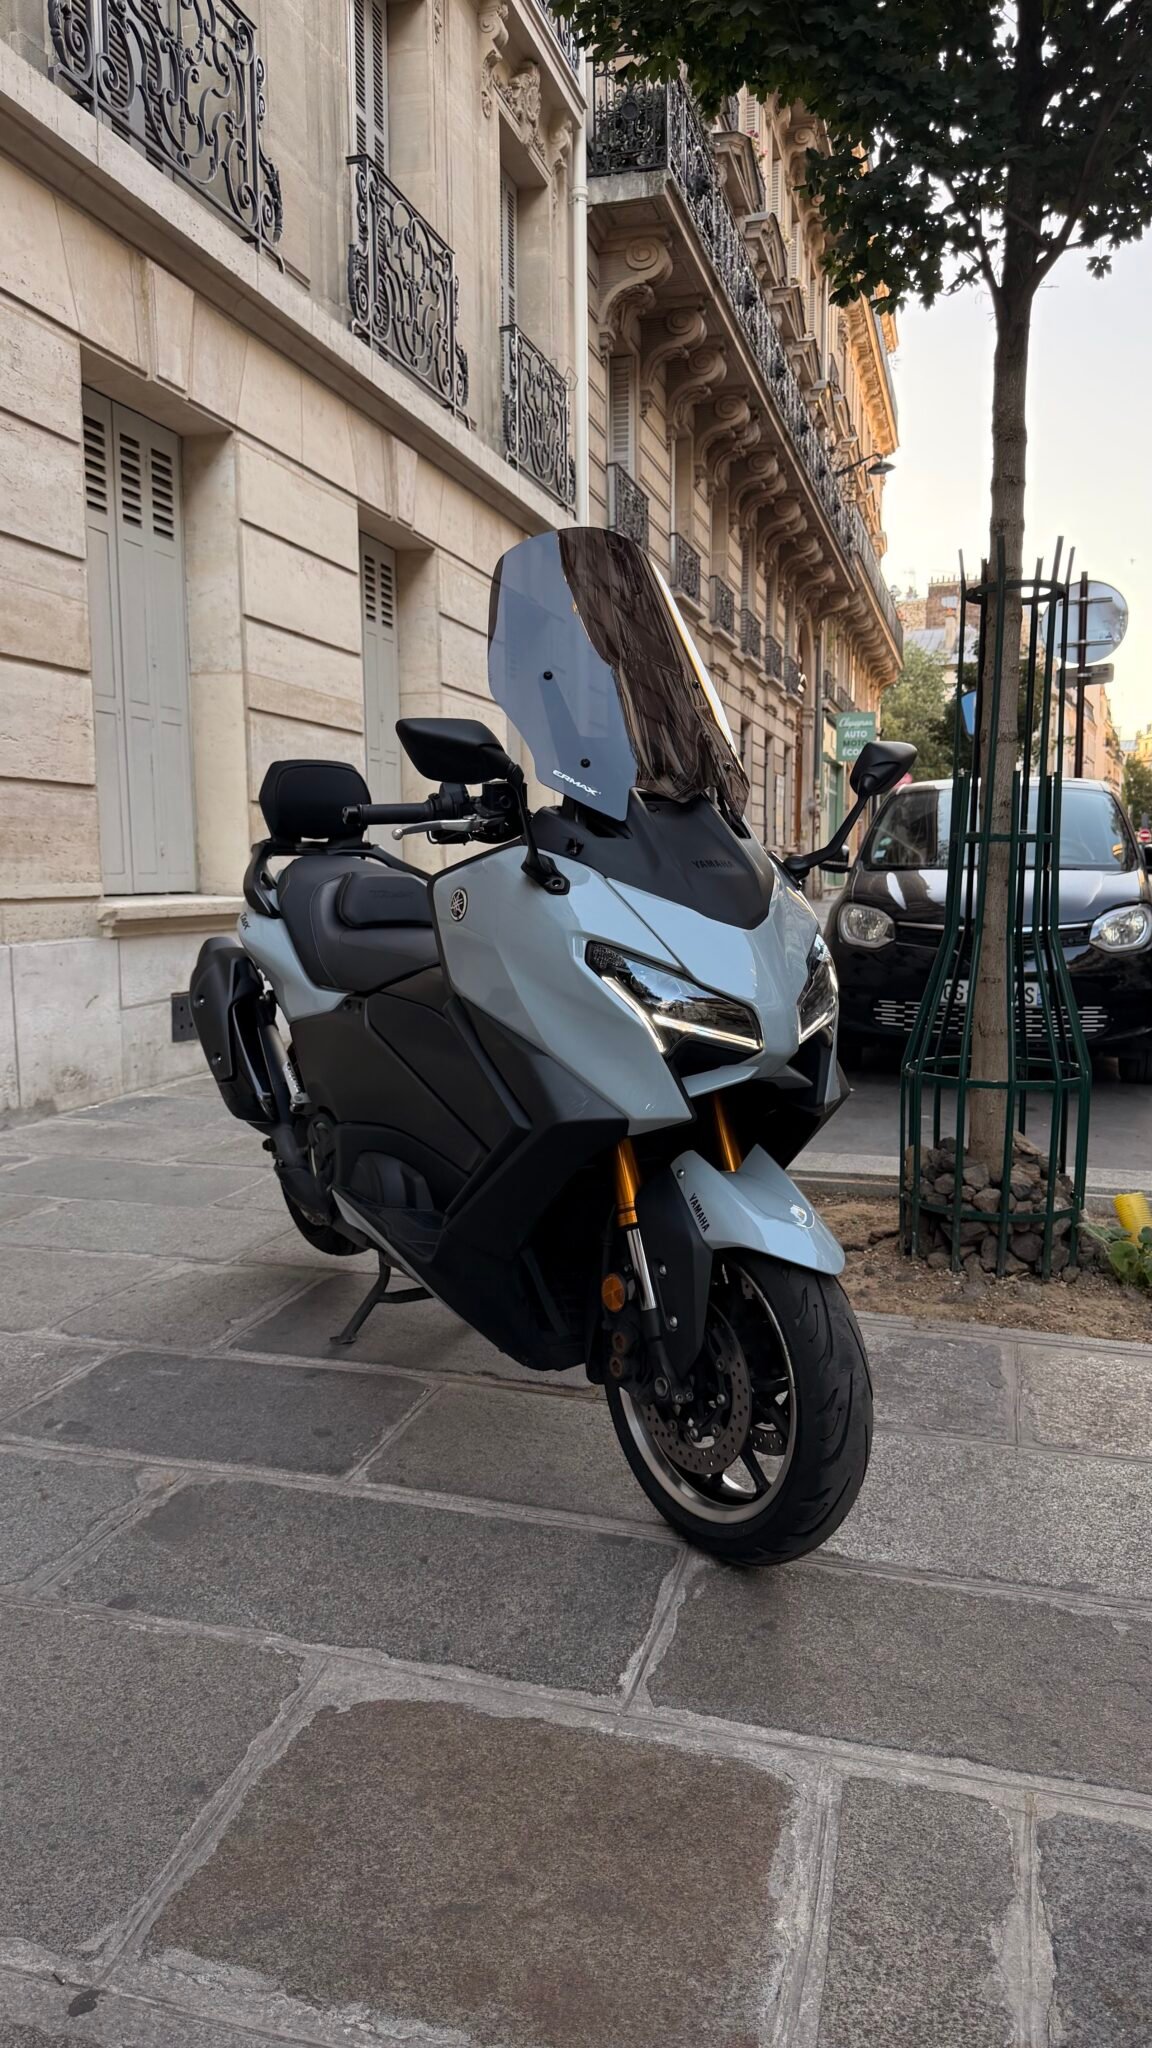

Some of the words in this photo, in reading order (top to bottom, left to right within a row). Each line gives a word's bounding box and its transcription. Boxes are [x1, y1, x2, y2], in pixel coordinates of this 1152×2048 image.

[844, 730, 868, 738] AUTO
[842, 747, 862, 756] ÉCO
[553, 770, 598, 796] ERMAX
[691, 859, 734, 869] YAMAHA
[690, 1193, 710, 1232] YAMAHA
